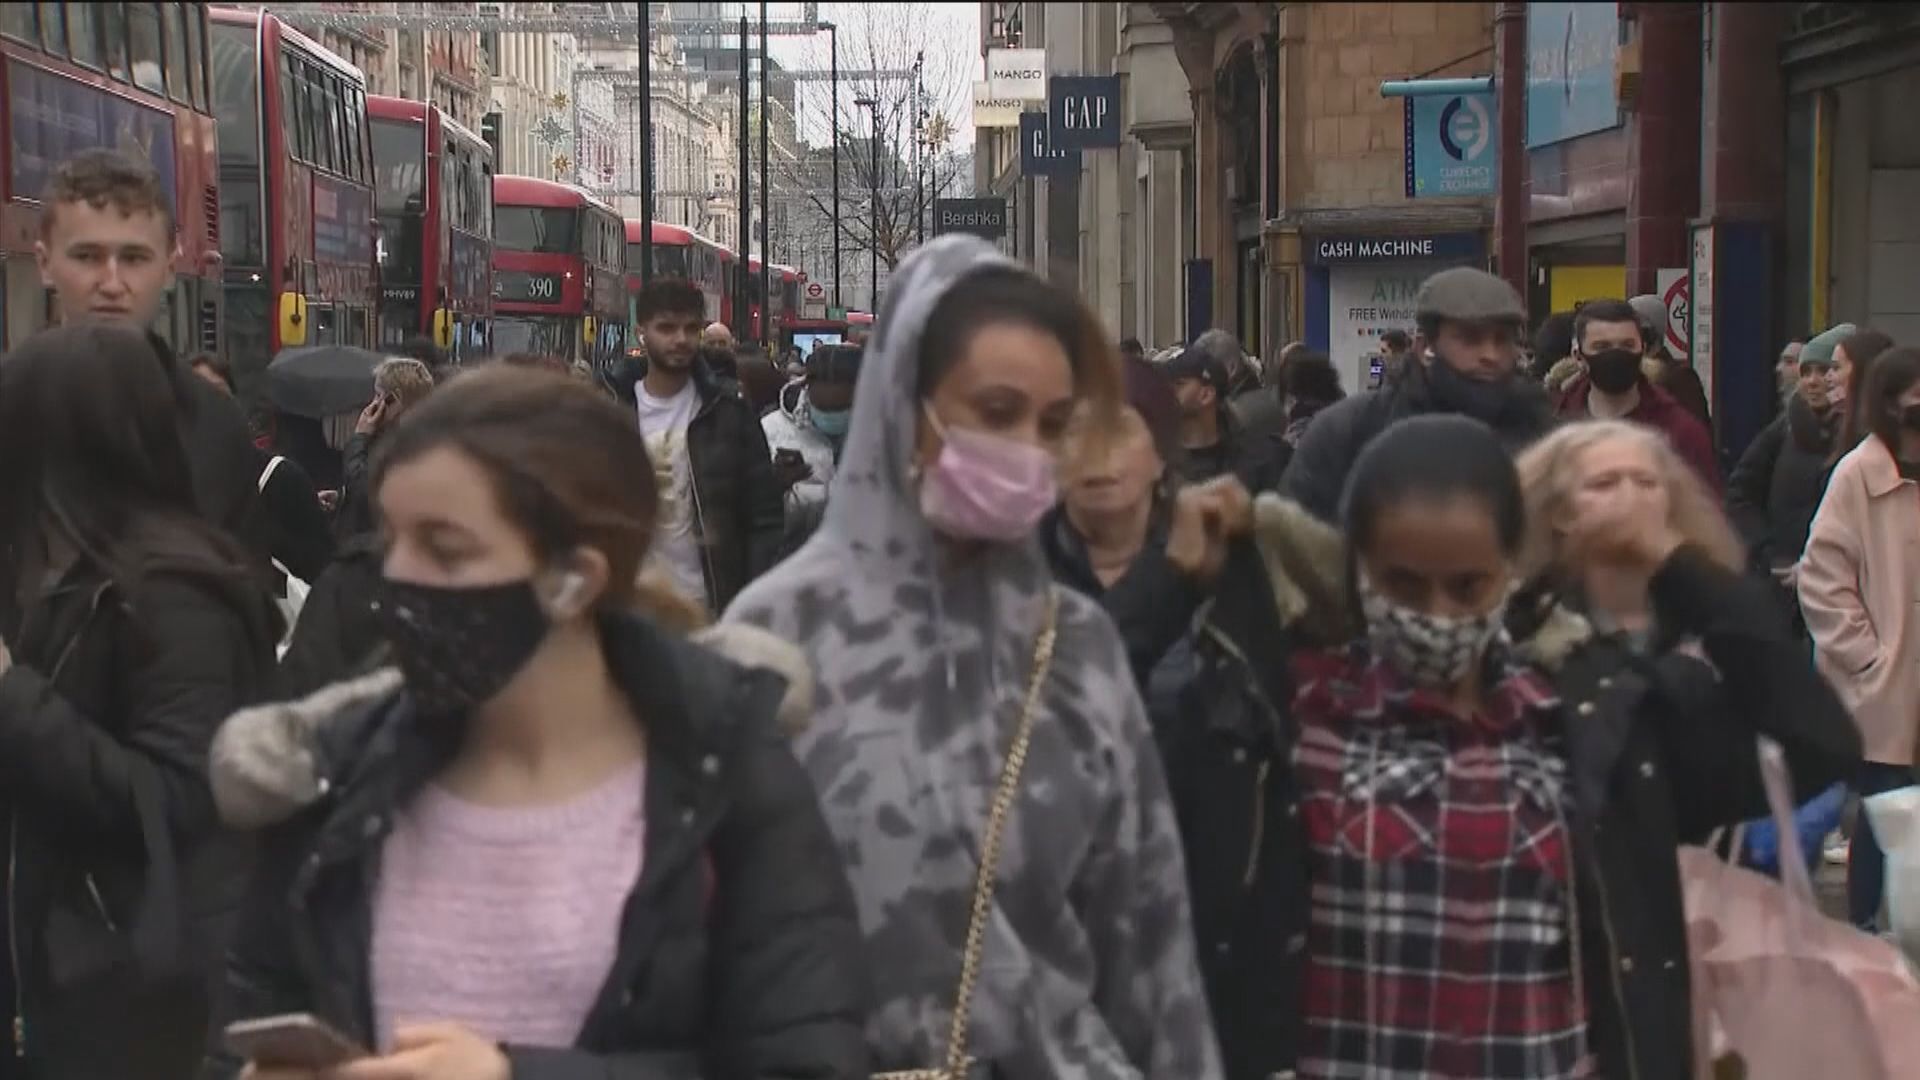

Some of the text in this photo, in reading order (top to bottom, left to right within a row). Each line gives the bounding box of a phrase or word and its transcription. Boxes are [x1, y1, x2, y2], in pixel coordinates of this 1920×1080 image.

[993, 69, 1042, 80] MANGO
[974, 98, 1021, 108] MANGO
[1064, 96, 1108, 129] GAP
[942, 211, 1000, 226] Bershka
[1320, 240, 1433, 258] CASH MACHINE
[528, 278, 553, 297] 390
[1349, 307, 1416, 321] FREE Withdr
